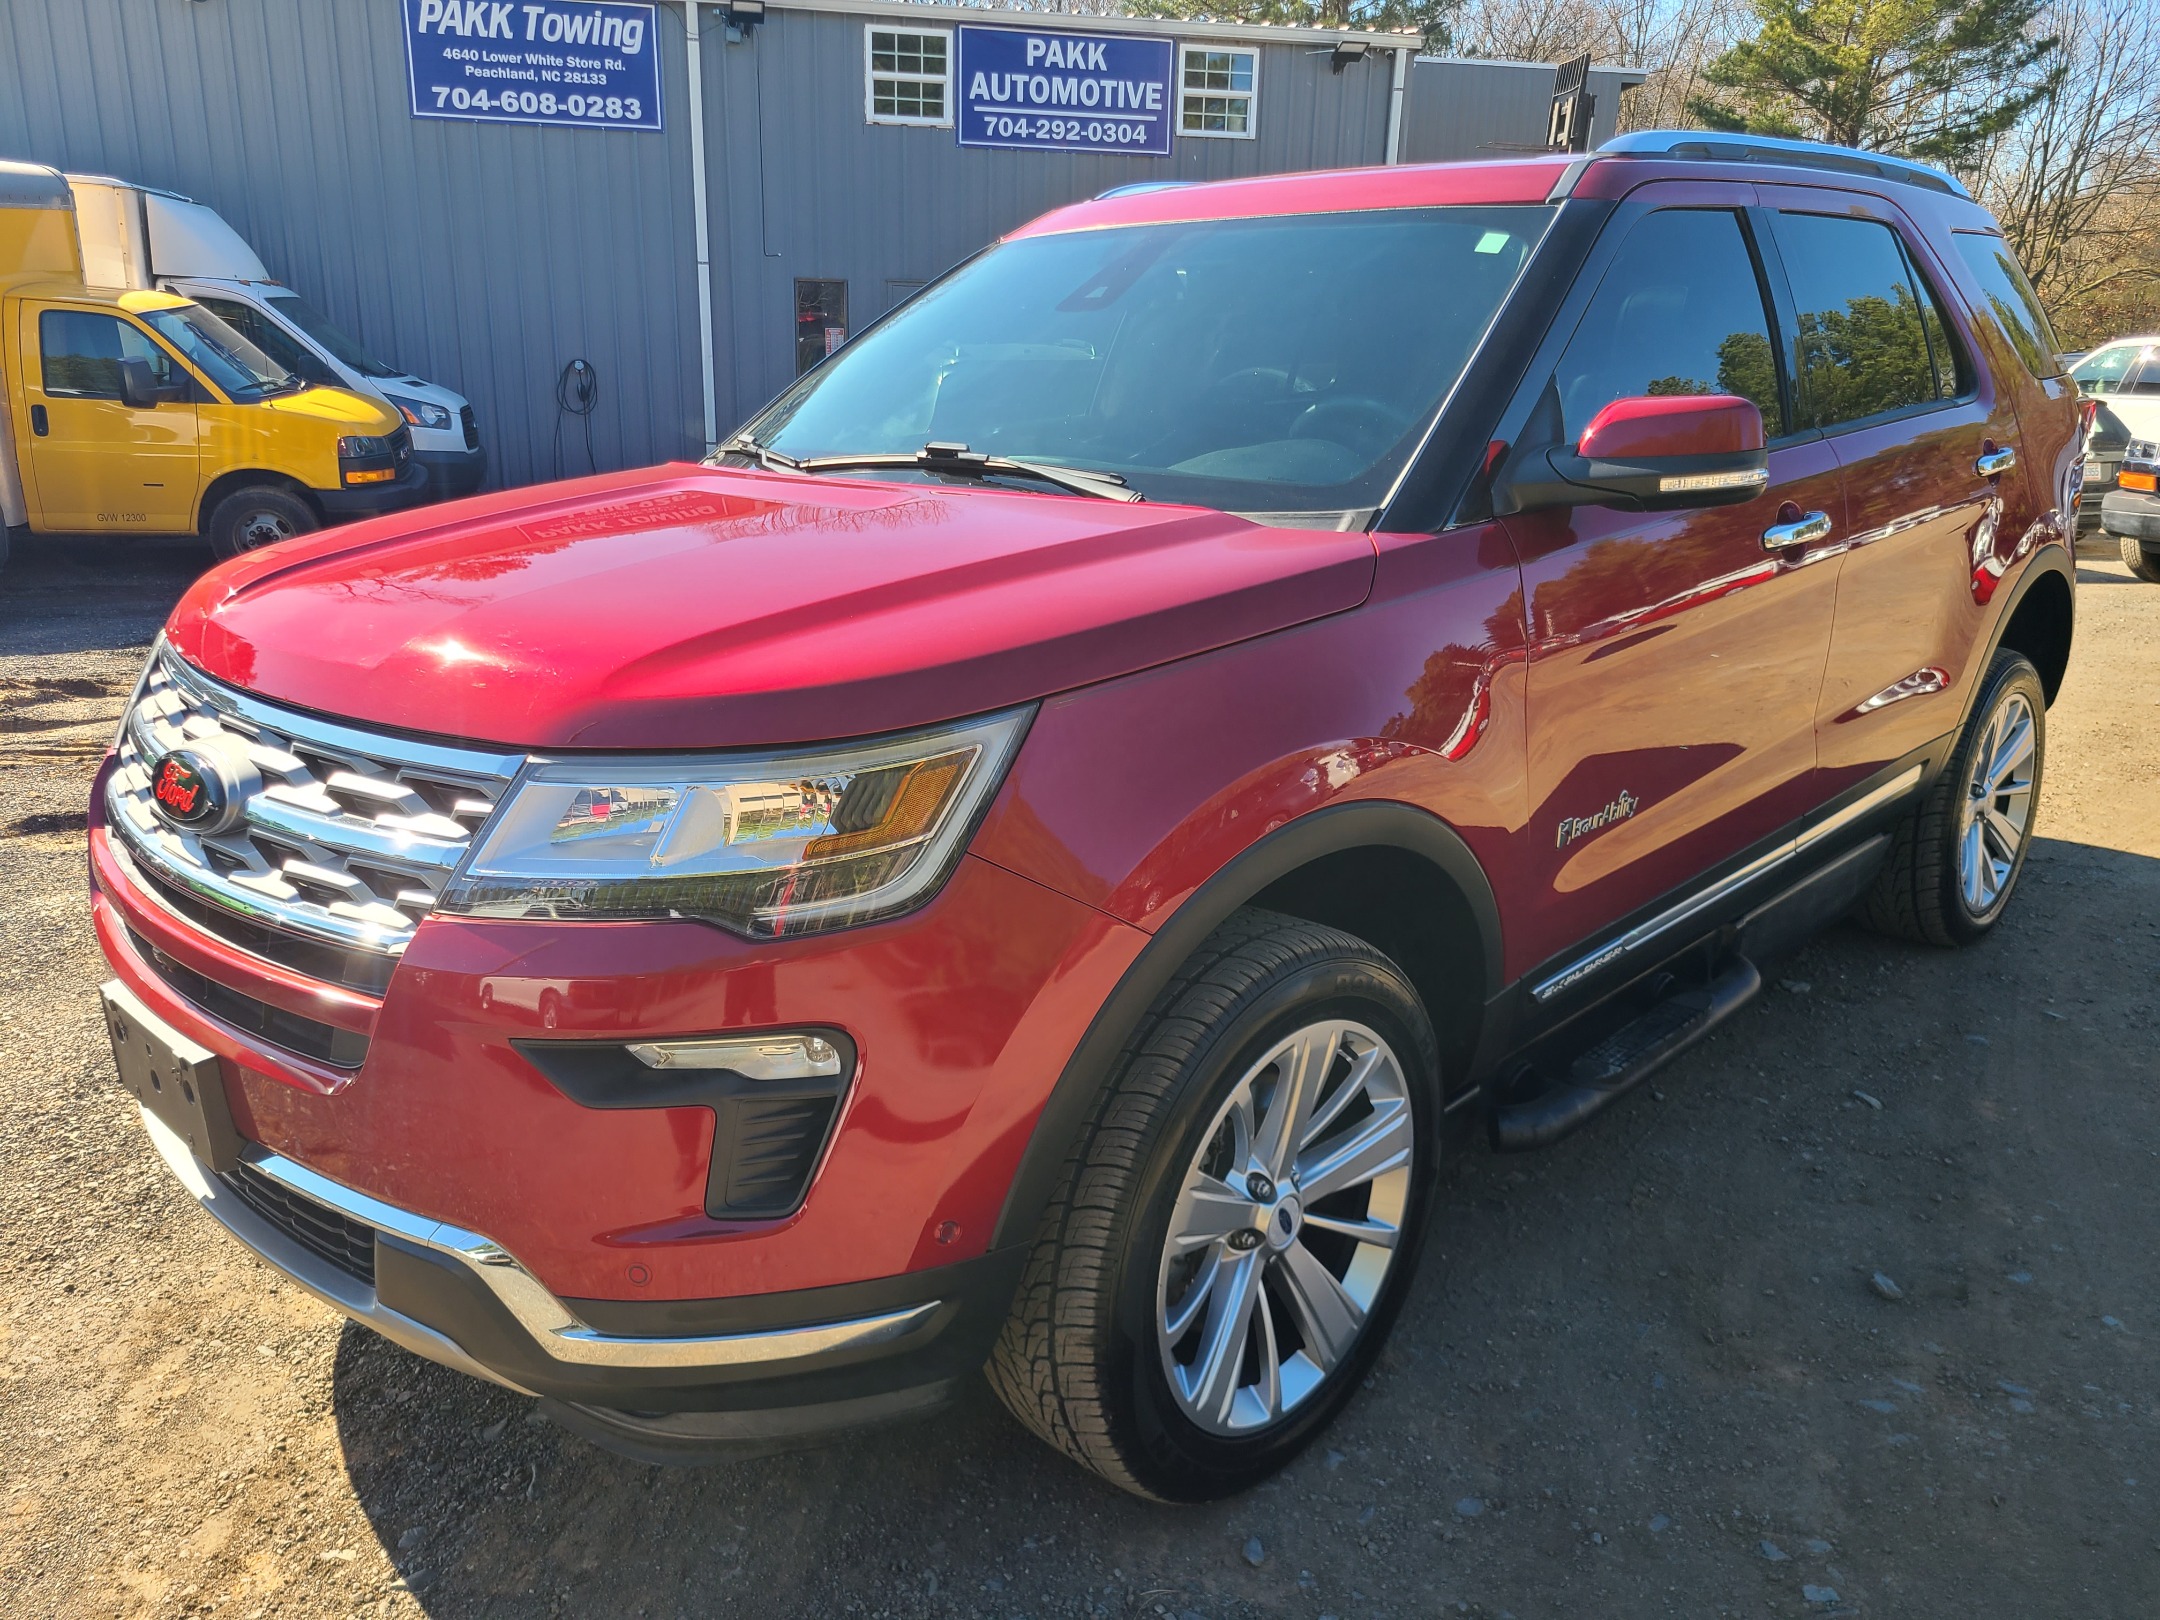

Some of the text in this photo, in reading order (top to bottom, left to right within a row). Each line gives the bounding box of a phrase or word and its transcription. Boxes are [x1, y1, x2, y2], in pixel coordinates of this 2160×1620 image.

[418, 0, 644, 54] PAKK Towing
[443, 47, 626, 71] 4640 Lower White Store Rd.
[1026, 38, 1107, 72] PAKK
[465, 65, 607, 85] Peachland, NC 28133
[969, 72, 1163, 110] AUTOMOTIVE
[431, 86, 642, 120] 704-608-0283
[983, 116, 1147, 145] 704-292-0304
[97, 513, 147, 522] GVW 12300
[156, 762, 200, 813] Ford
